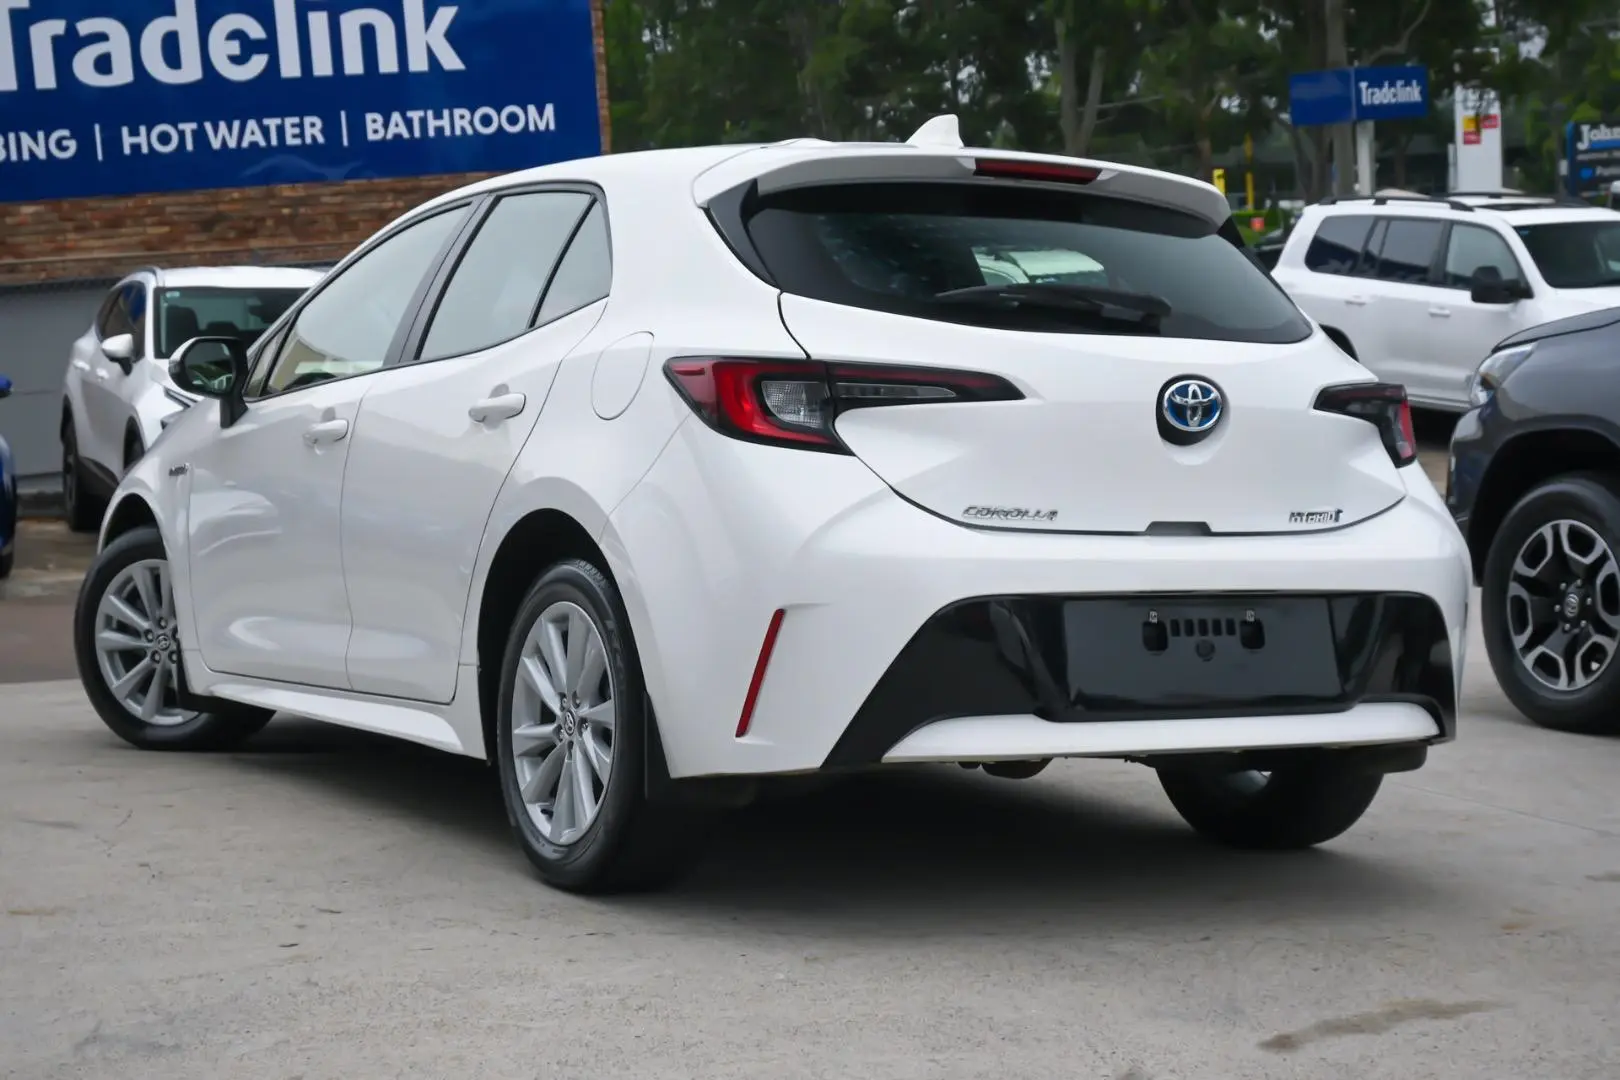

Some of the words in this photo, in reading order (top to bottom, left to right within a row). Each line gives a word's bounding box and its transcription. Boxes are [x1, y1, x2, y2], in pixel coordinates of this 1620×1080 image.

[121, 122, 198, 155] HOT
[203, 115, 325, 150] WATER
[365, 103, 556, 141] BATHROOM
